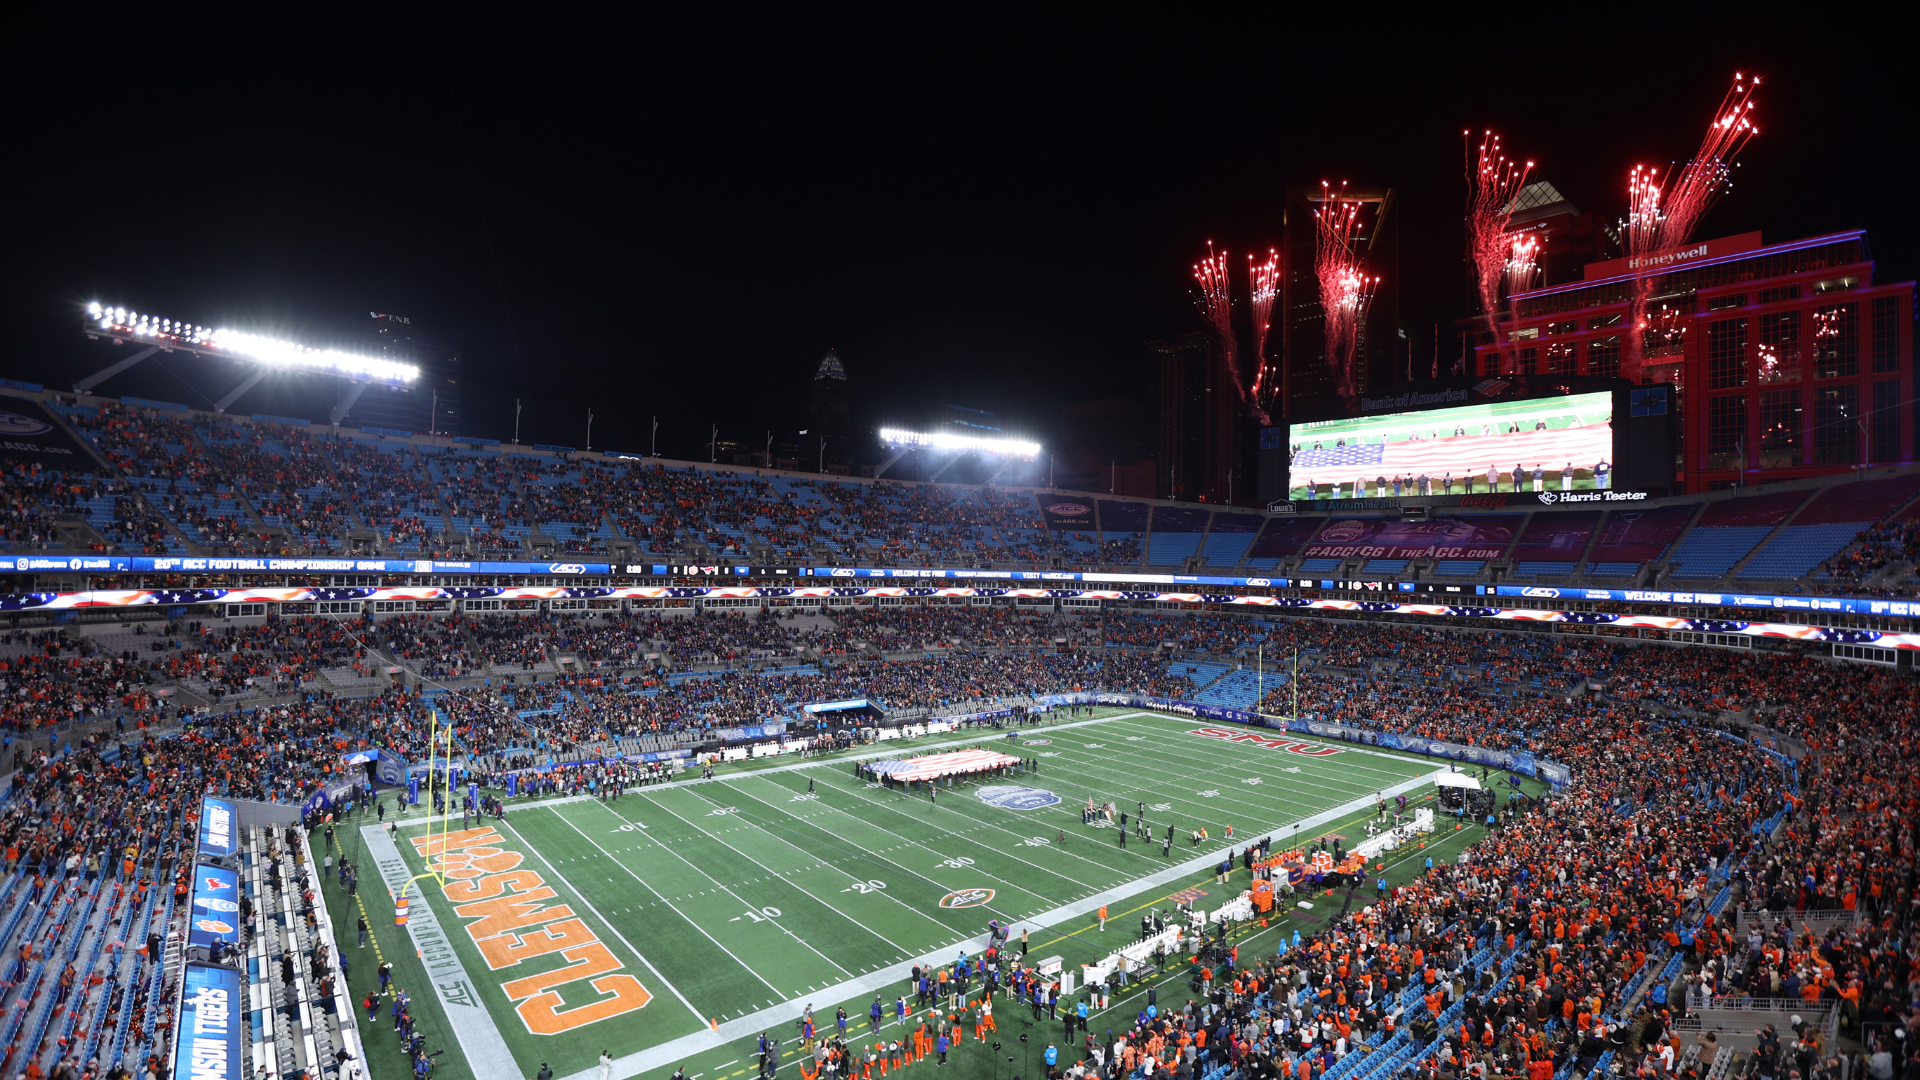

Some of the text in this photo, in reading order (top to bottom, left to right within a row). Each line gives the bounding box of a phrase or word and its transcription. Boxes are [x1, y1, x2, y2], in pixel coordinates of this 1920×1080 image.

[1629, 245, 1708, 269] Honeywell
[1362, 389, 1468, 410] Bank of America
[1560, 491, 1647, 502] Harris Teeter
[1270, 504, 1294, 512] LOWE'S
[1328, 499, 1400, 510] Atrium Health
[154, 558, 386, 571] 20TH ACC FOOTBALL CHAMPIONSHIP GAME
[892, 570, 920, 578] WELCOME
[1624, 591, 1721, 604] WELCOME ACC FANS
[1890, 603, 1908, 614] ACC
[1186, 727, 1346, 757] SMU
[620, 821, 649, 832] 10
[1025, 836, 1050, 847] 40
[943, 856, 975, 869] 30
[852, 879, 887, 894] 20
[950, 889, 988, 906] ACC
[744, 906, 782, 923] 10
[188, 986, 230, 1035] TIGERS
